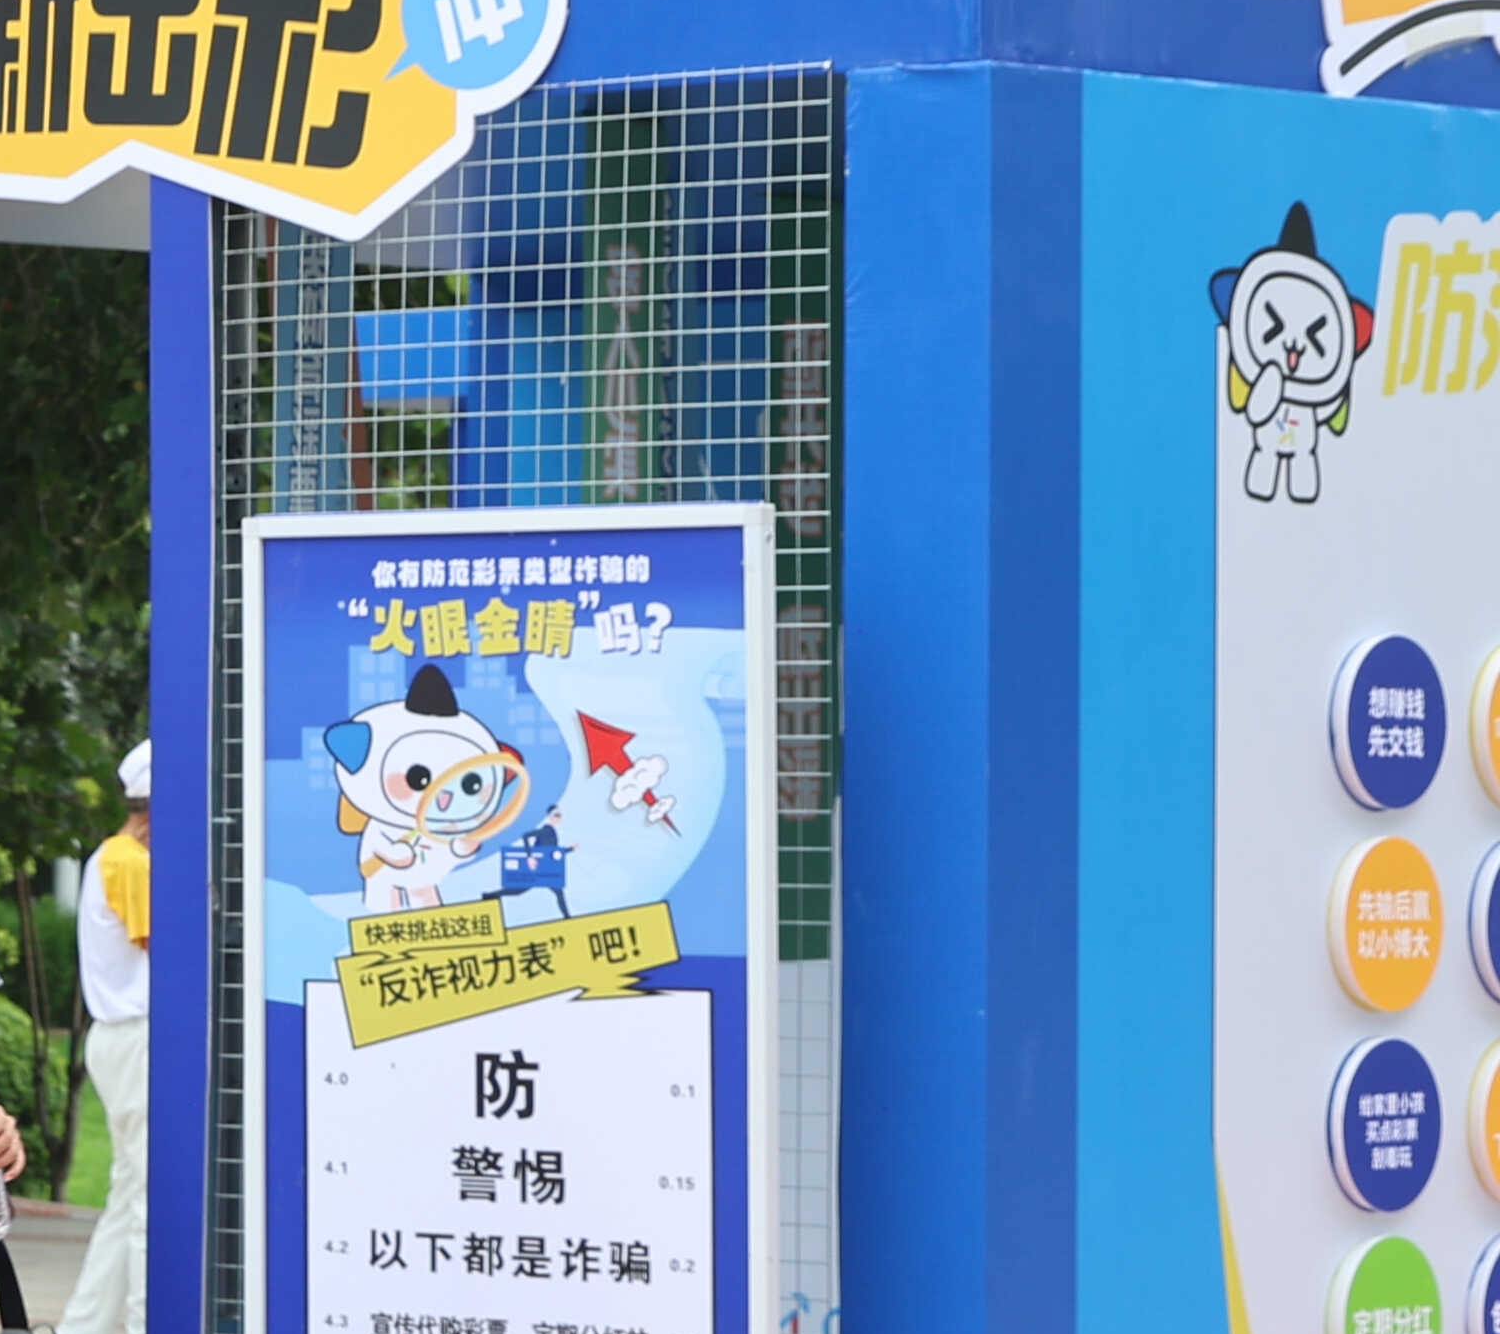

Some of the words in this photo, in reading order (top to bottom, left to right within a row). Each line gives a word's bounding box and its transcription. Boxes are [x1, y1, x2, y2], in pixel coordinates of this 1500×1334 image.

[1382, 240, 1500, 399] 防
[1368, 724, 1424, 758] 先交钱
[365, 915, 493, 945] 快来挑战这组
[325, 1073, 349, 1085] 4.0
[475, 1050, 539, 1119] 防
[670, 1084, 695, 1098] 0.1
[325, 1162, 348, 1174] 4.1
[452, 1144, 566, 1205] 警惕
[658, 1176, 695, 1191] 0.15
[325, 1241, 349, 1253] 4.2
[368, 1229, 651, 1284] 以下都是诈骗
[669, 1259, 695, 1273] 0.2
[325, 1315, 349, 1327] 4.3
